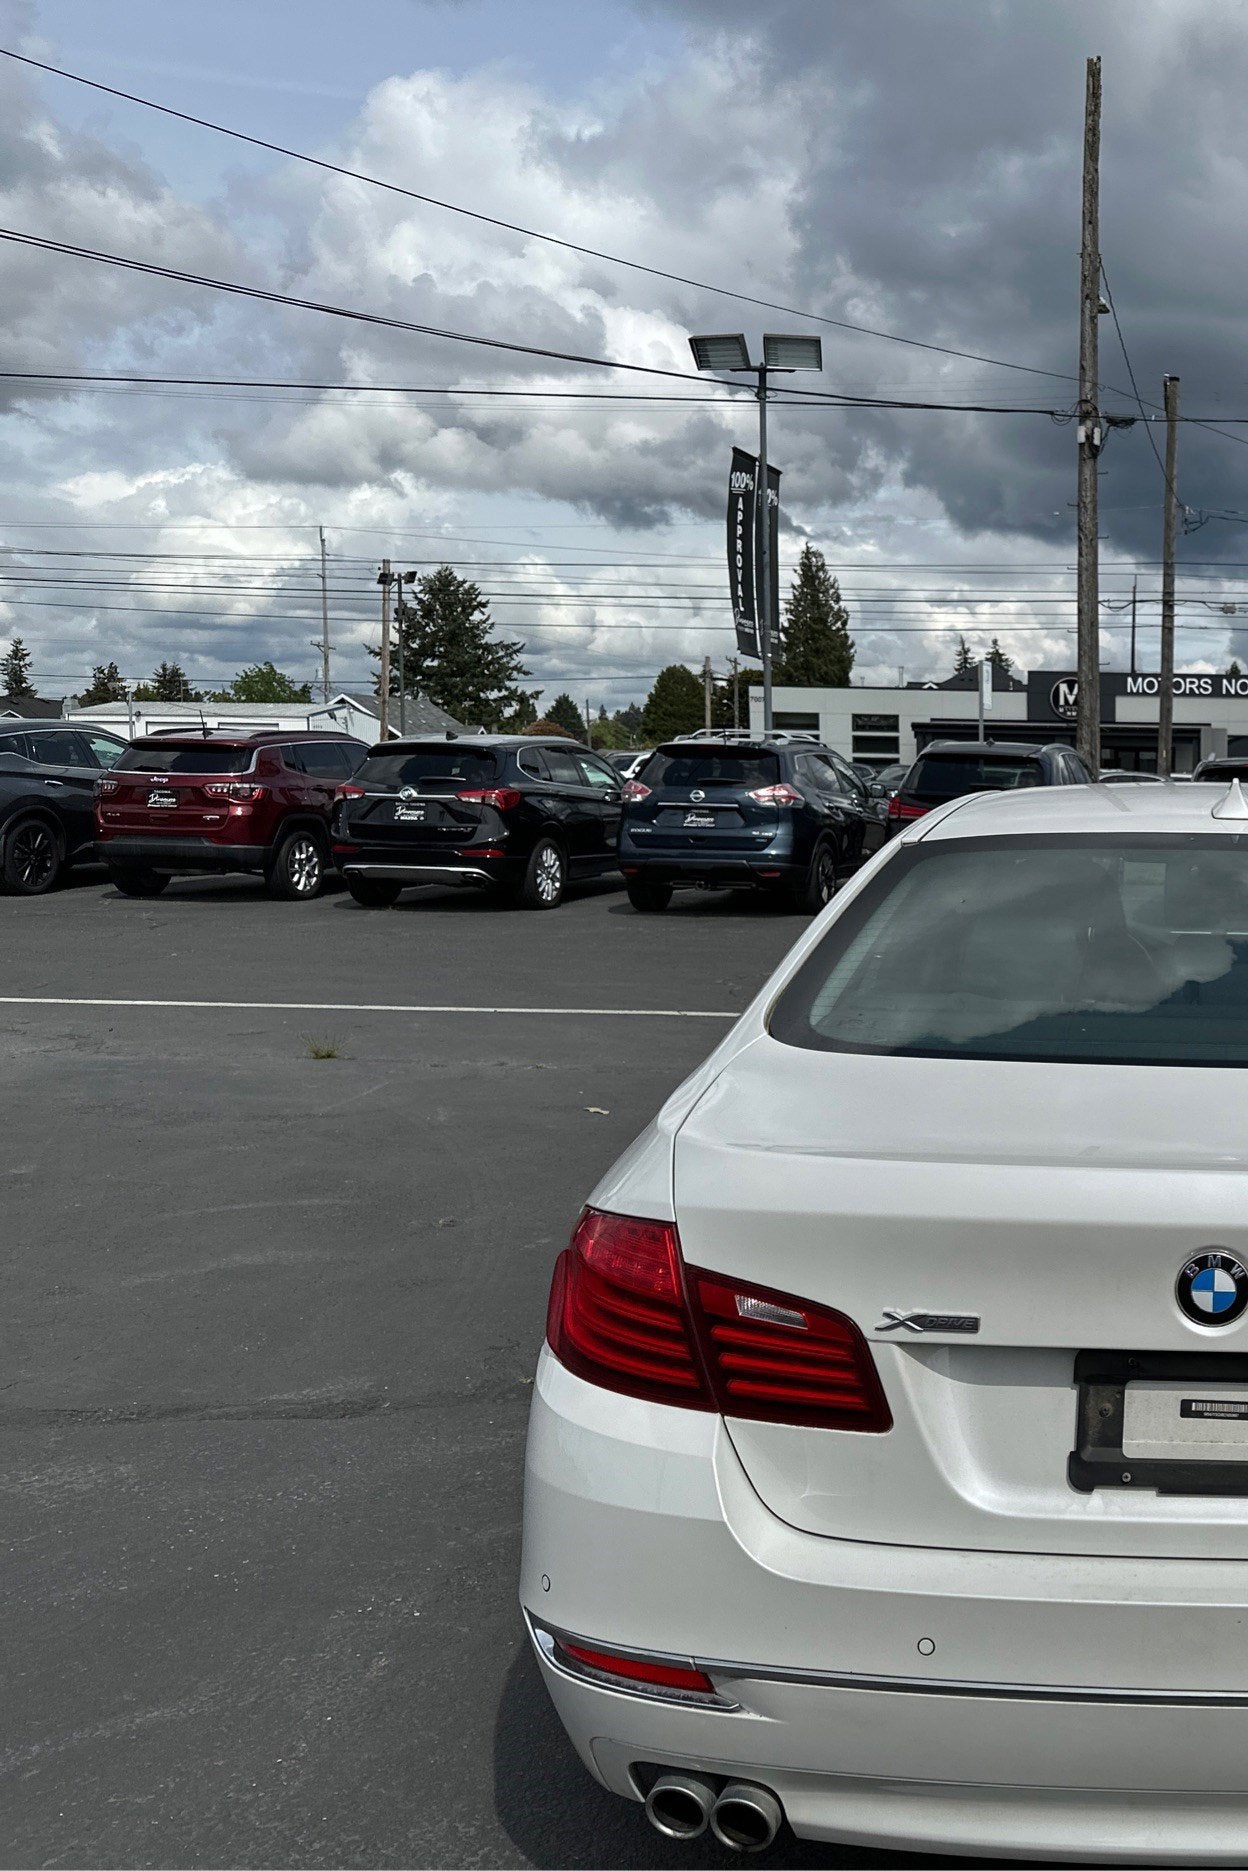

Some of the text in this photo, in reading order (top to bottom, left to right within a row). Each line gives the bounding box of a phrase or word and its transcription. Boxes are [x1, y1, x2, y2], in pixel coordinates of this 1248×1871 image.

[730, 471, 753, 491] 100%
[736, 496, 745, 611] APPROVAL
[1185, 1255, 1246, 1280] BMW
